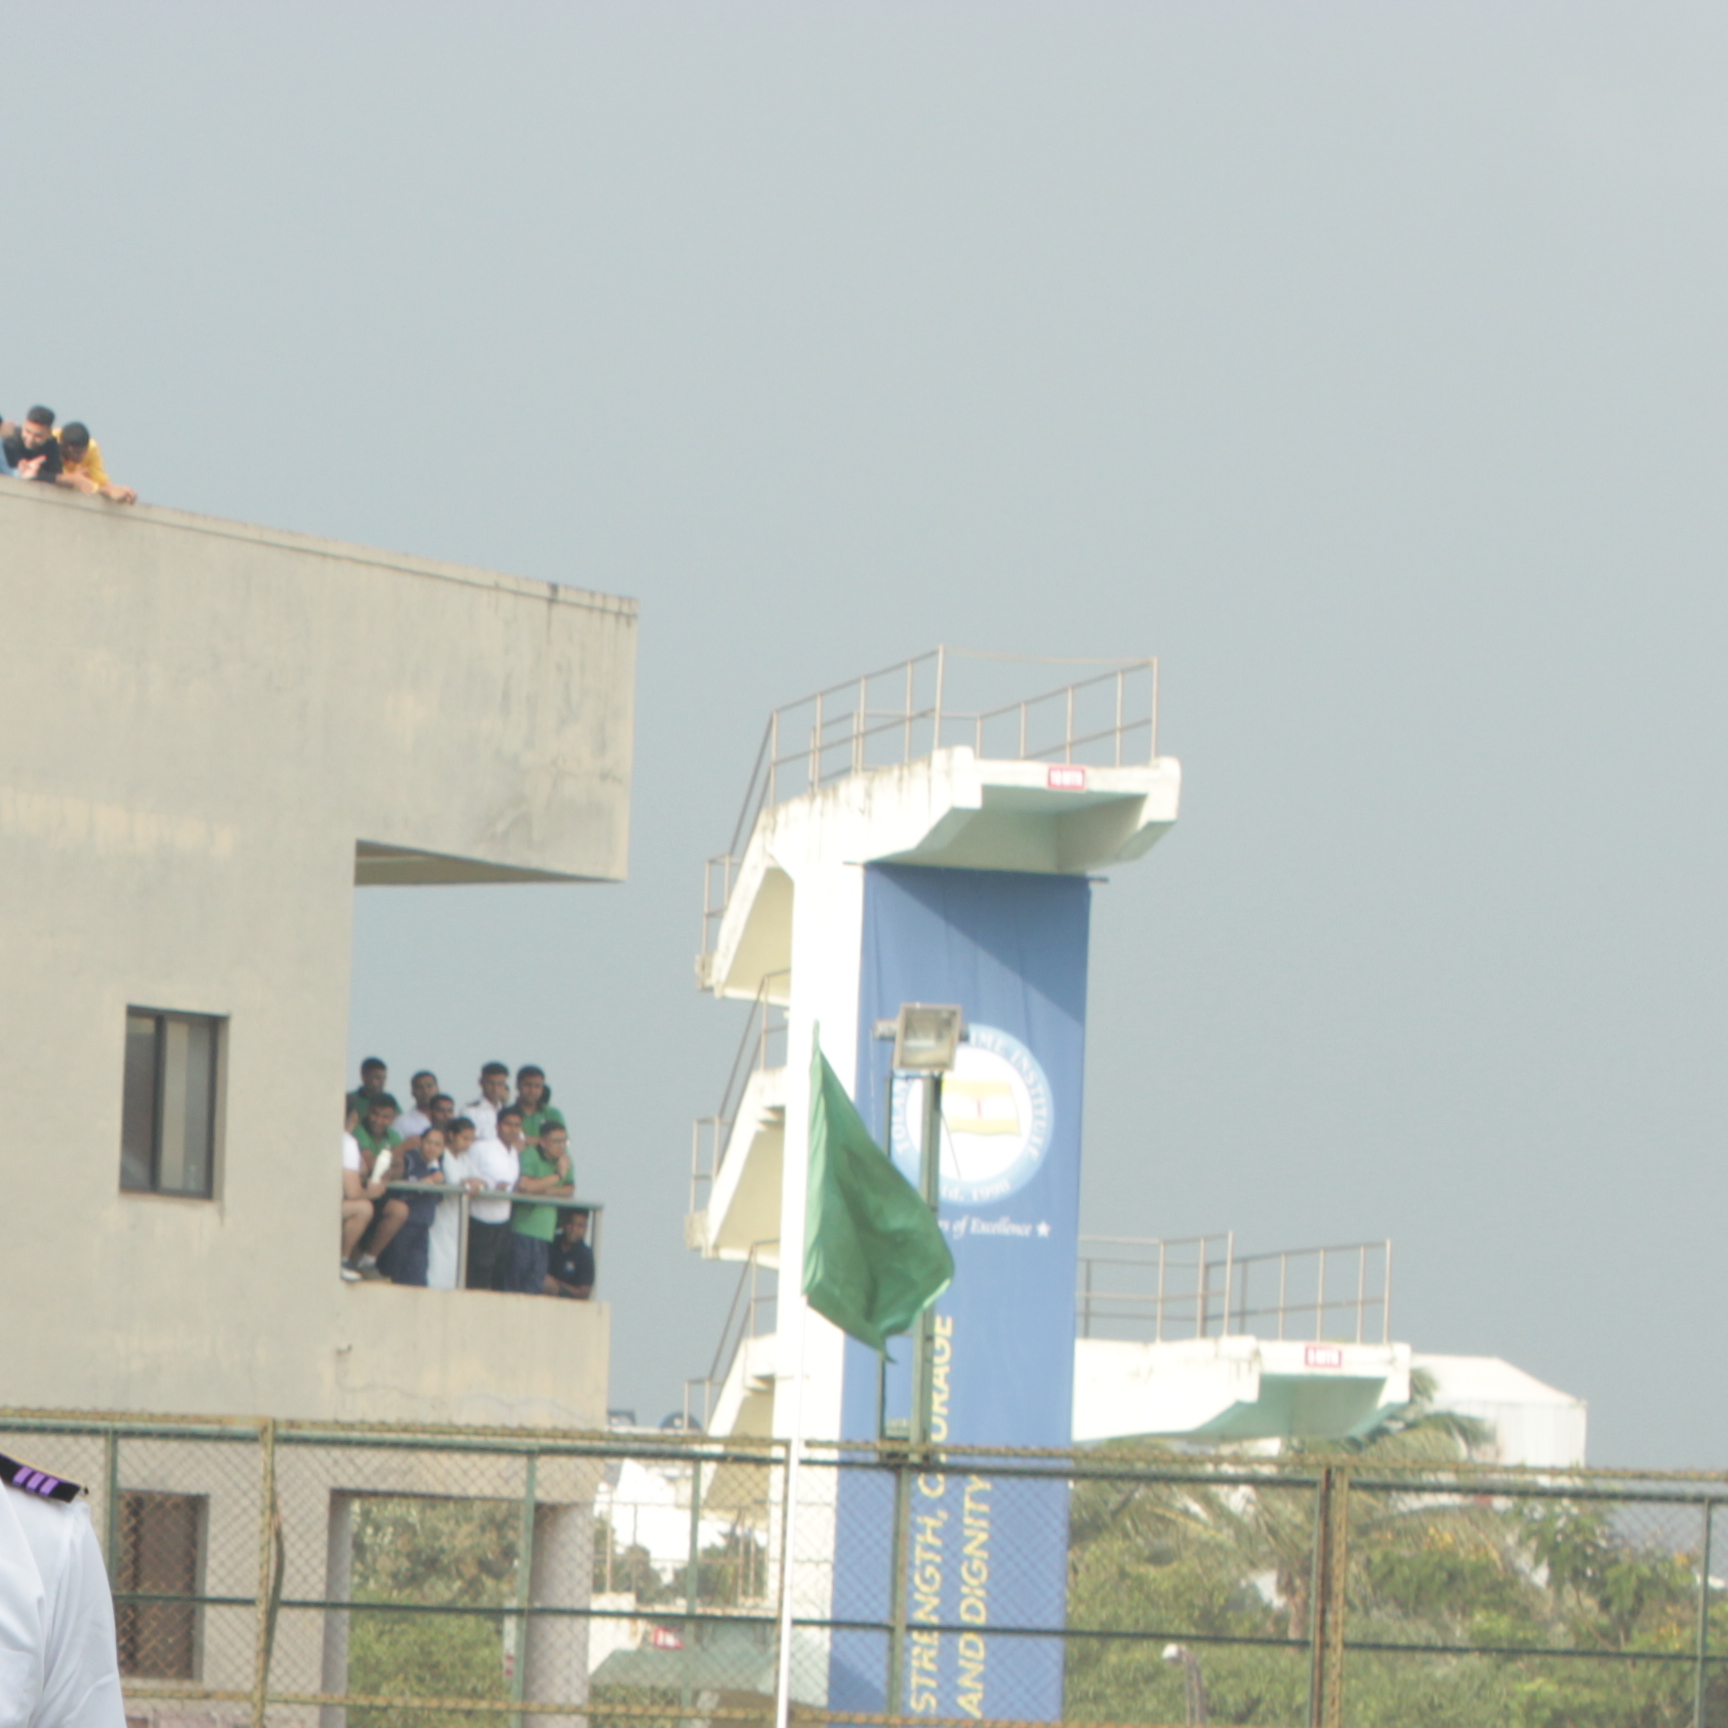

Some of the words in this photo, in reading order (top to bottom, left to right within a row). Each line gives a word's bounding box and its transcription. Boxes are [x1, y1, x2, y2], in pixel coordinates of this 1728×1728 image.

[1010, 1050, 1049, 1162] INSTITUTE
[952, 1213, 971, 1240] of
[971, 1214, 1033, 1237] Excellence
[917, 1314, 954, 1499] CURAGE
[909, 1508, 949, 1716] STRENGTH,
[959, 1473, 992, 1626] DIGNITY
[956, 1631, 987, 1720] AND
